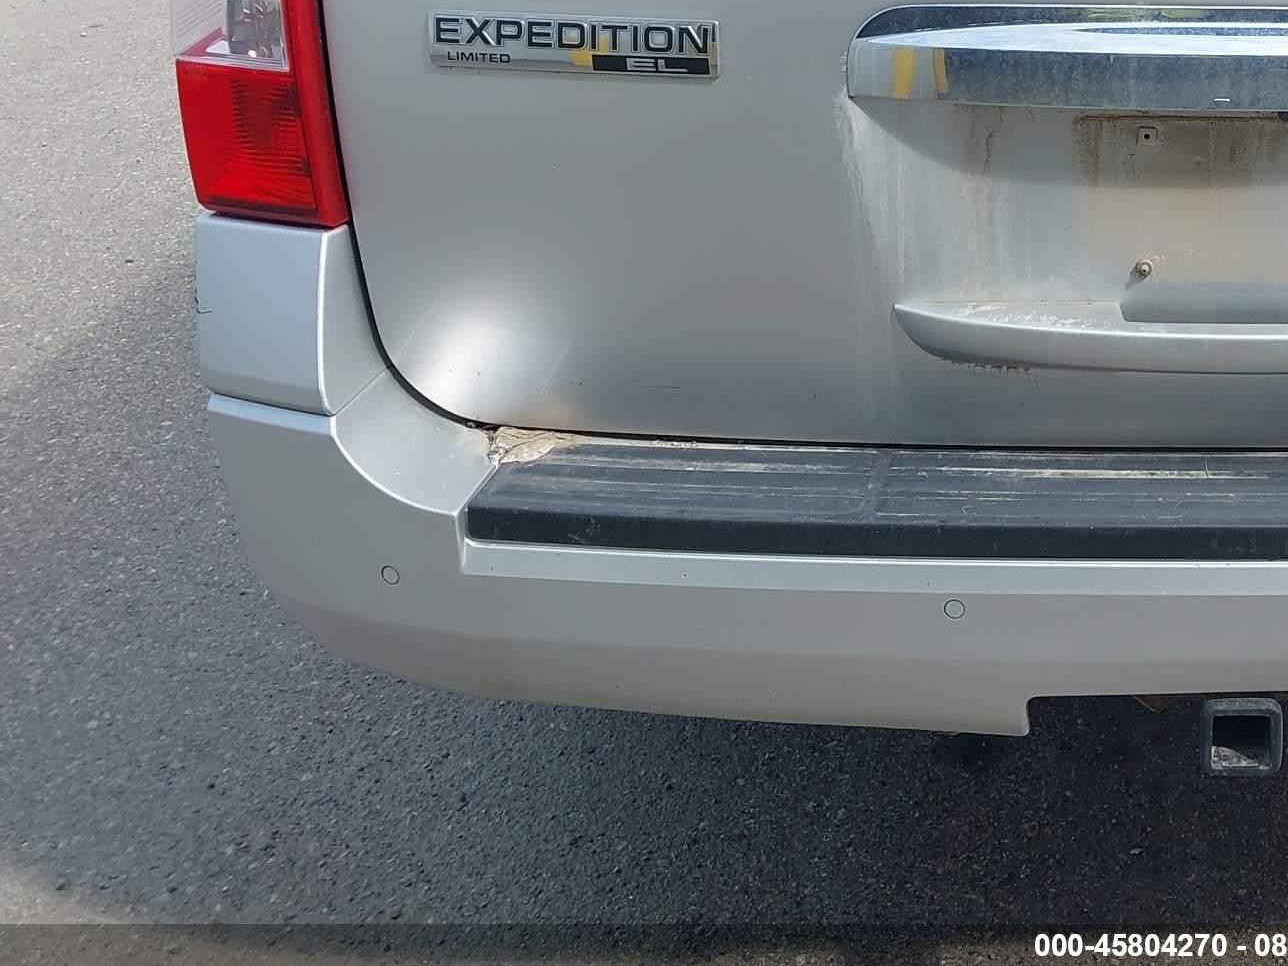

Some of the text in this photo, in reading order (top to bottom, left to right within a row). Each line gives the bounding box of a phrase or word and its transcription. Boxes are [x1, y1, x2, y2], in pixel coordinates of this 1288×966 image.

[433, 15, 710, 55] EXPEDITION
[446, 50, 511, 64] LIMITED
[625, 57, 689, 73] EL
